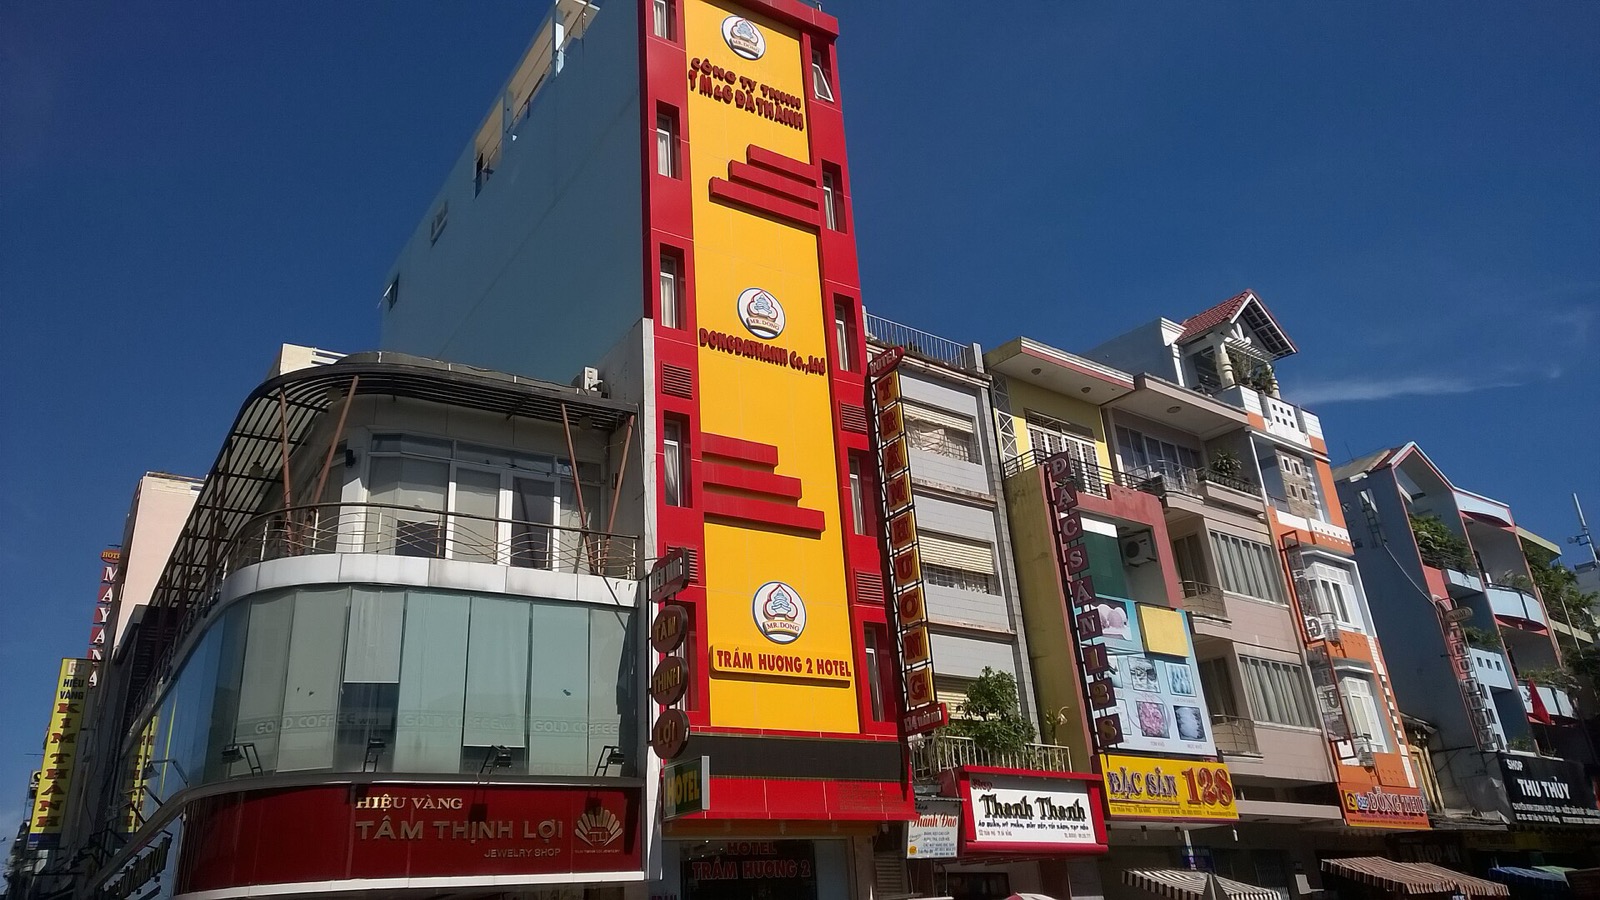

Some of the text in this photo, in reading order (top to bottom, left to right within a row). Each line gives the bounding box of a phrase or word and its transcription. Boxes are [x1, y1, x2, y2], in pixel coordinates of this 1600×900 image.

[690, 57, 802, 110] CÔNG TY TNHH
[698, 327, 789, 368] DONGDATHANH
[868, 348, 898, 372] HOTEL
[102, 551, 121, 560] HOTE
[655, 616, 678, 643] TÂM
[779, 622, 800, 632] DONG
[716, 646, 852, 678] TRẦM HƯƠNG 2 HOTEL
[653, 665, 681, 696] THỊNH
[59, 689, 84, 700] VÀNG
[50, 702, 81, 744] KIM
[255, 715, 293, 735] GOD
[535, 720, 619, 735] GOLD COFFEE
[1506, 758, 1524, 772] SHOP
[667, 769, 700, 809] HOTEL
[1181, 767, 1233, 807] 128
[1517, 778, 1541, 798] THU
[355, 794, 464, 811] HIỆU VÀNG
[978, 793, 1035, 820] Thanh
[1034, 796, 1087, 822] Thanh
[355, 815, 563, 845] TÂM THỊNH LỢI
[484, 848, 533, 859] JEWELRY
[534, 847, 561, 858] SHOP
[727, 841, 778, 856] HOTEL
[742, 859, 798, 880] HƯƠNG
[800, 858, 811, 879] 2
